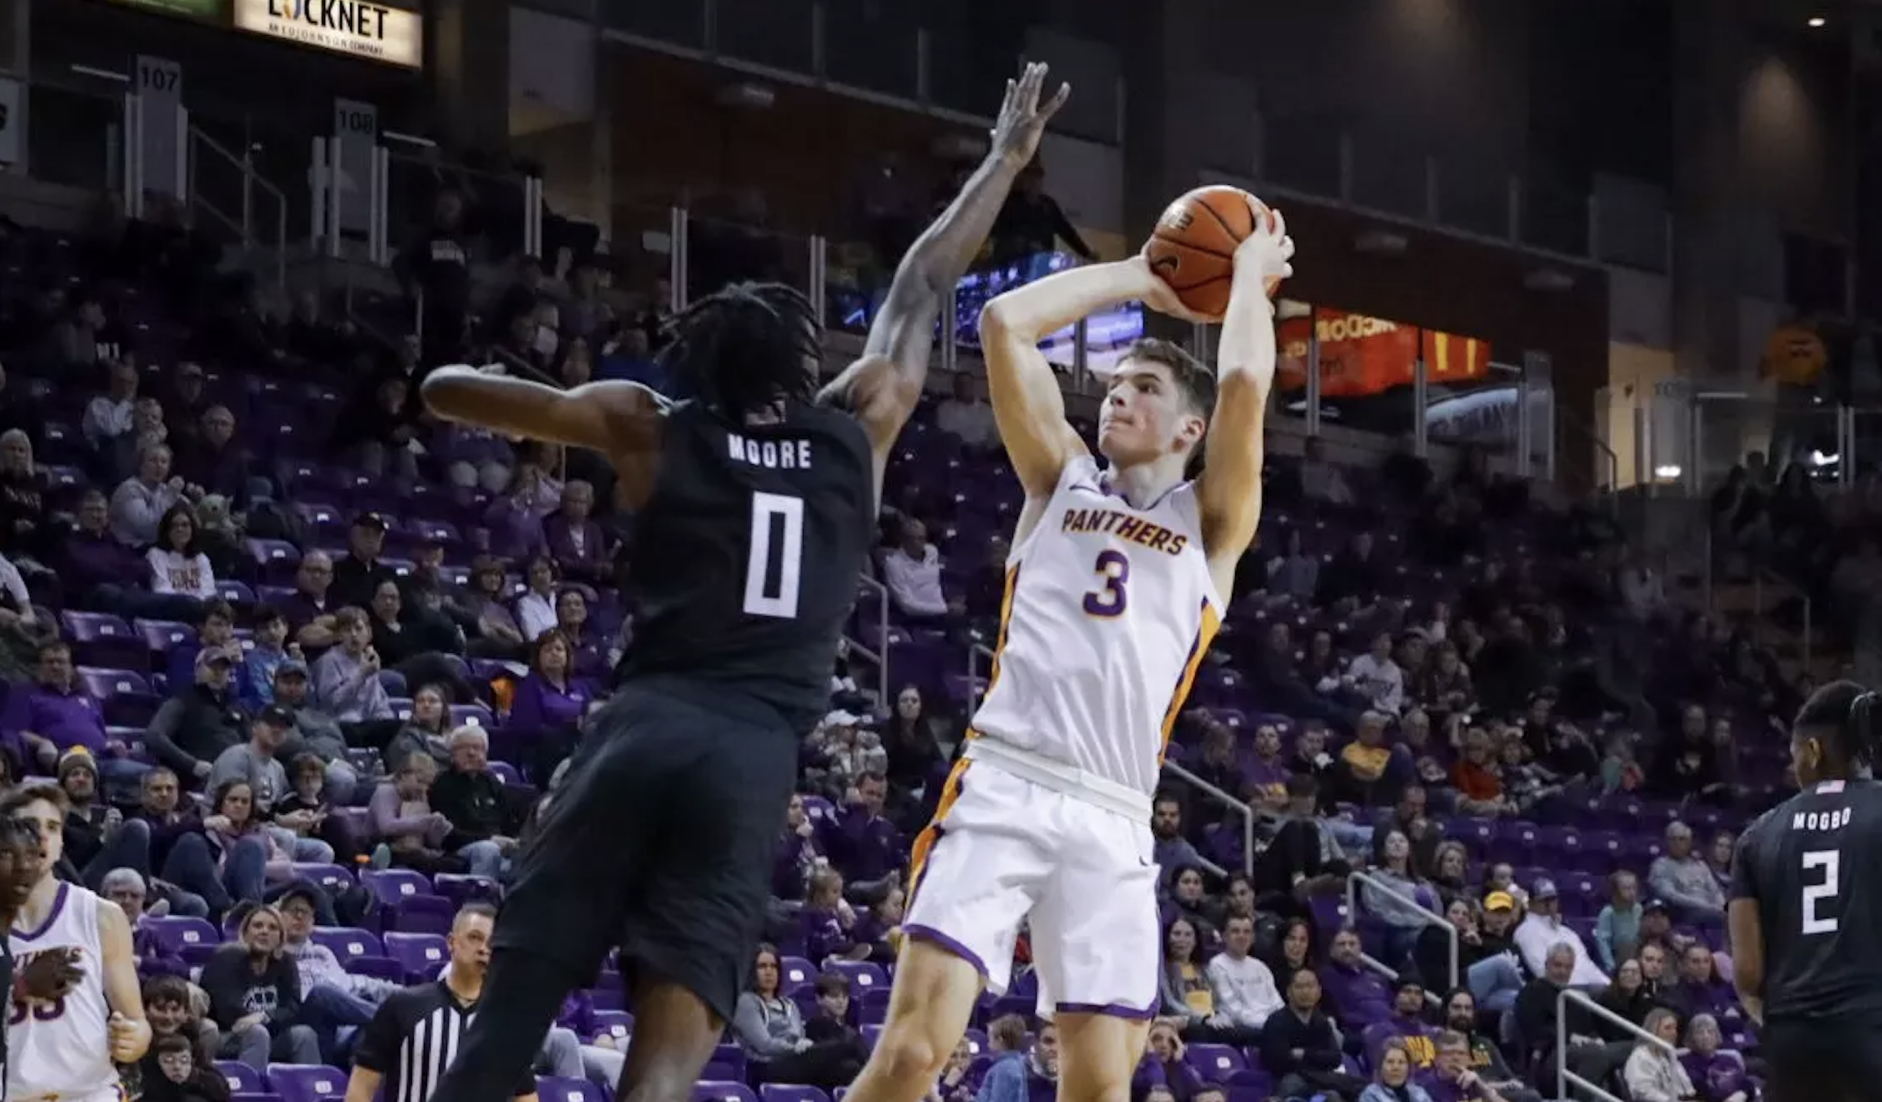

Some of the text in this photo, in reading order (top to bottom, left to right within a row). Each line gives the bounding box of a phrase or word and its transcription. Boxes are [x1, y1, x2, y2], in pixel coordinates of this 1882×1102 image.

[141, 65, 178, 92] 107
[339, 109, 374, 135] 108
[727, 433, 811, 469] MOORE
[1061, 508, 1188, 556] PANTHERS
[743, 490, 804, 618] 0
[1082, 549, 1130, 618] 3
[1793, 806, 1851, 830] MOGBO
[1802, 849, 1840, 934] 2
